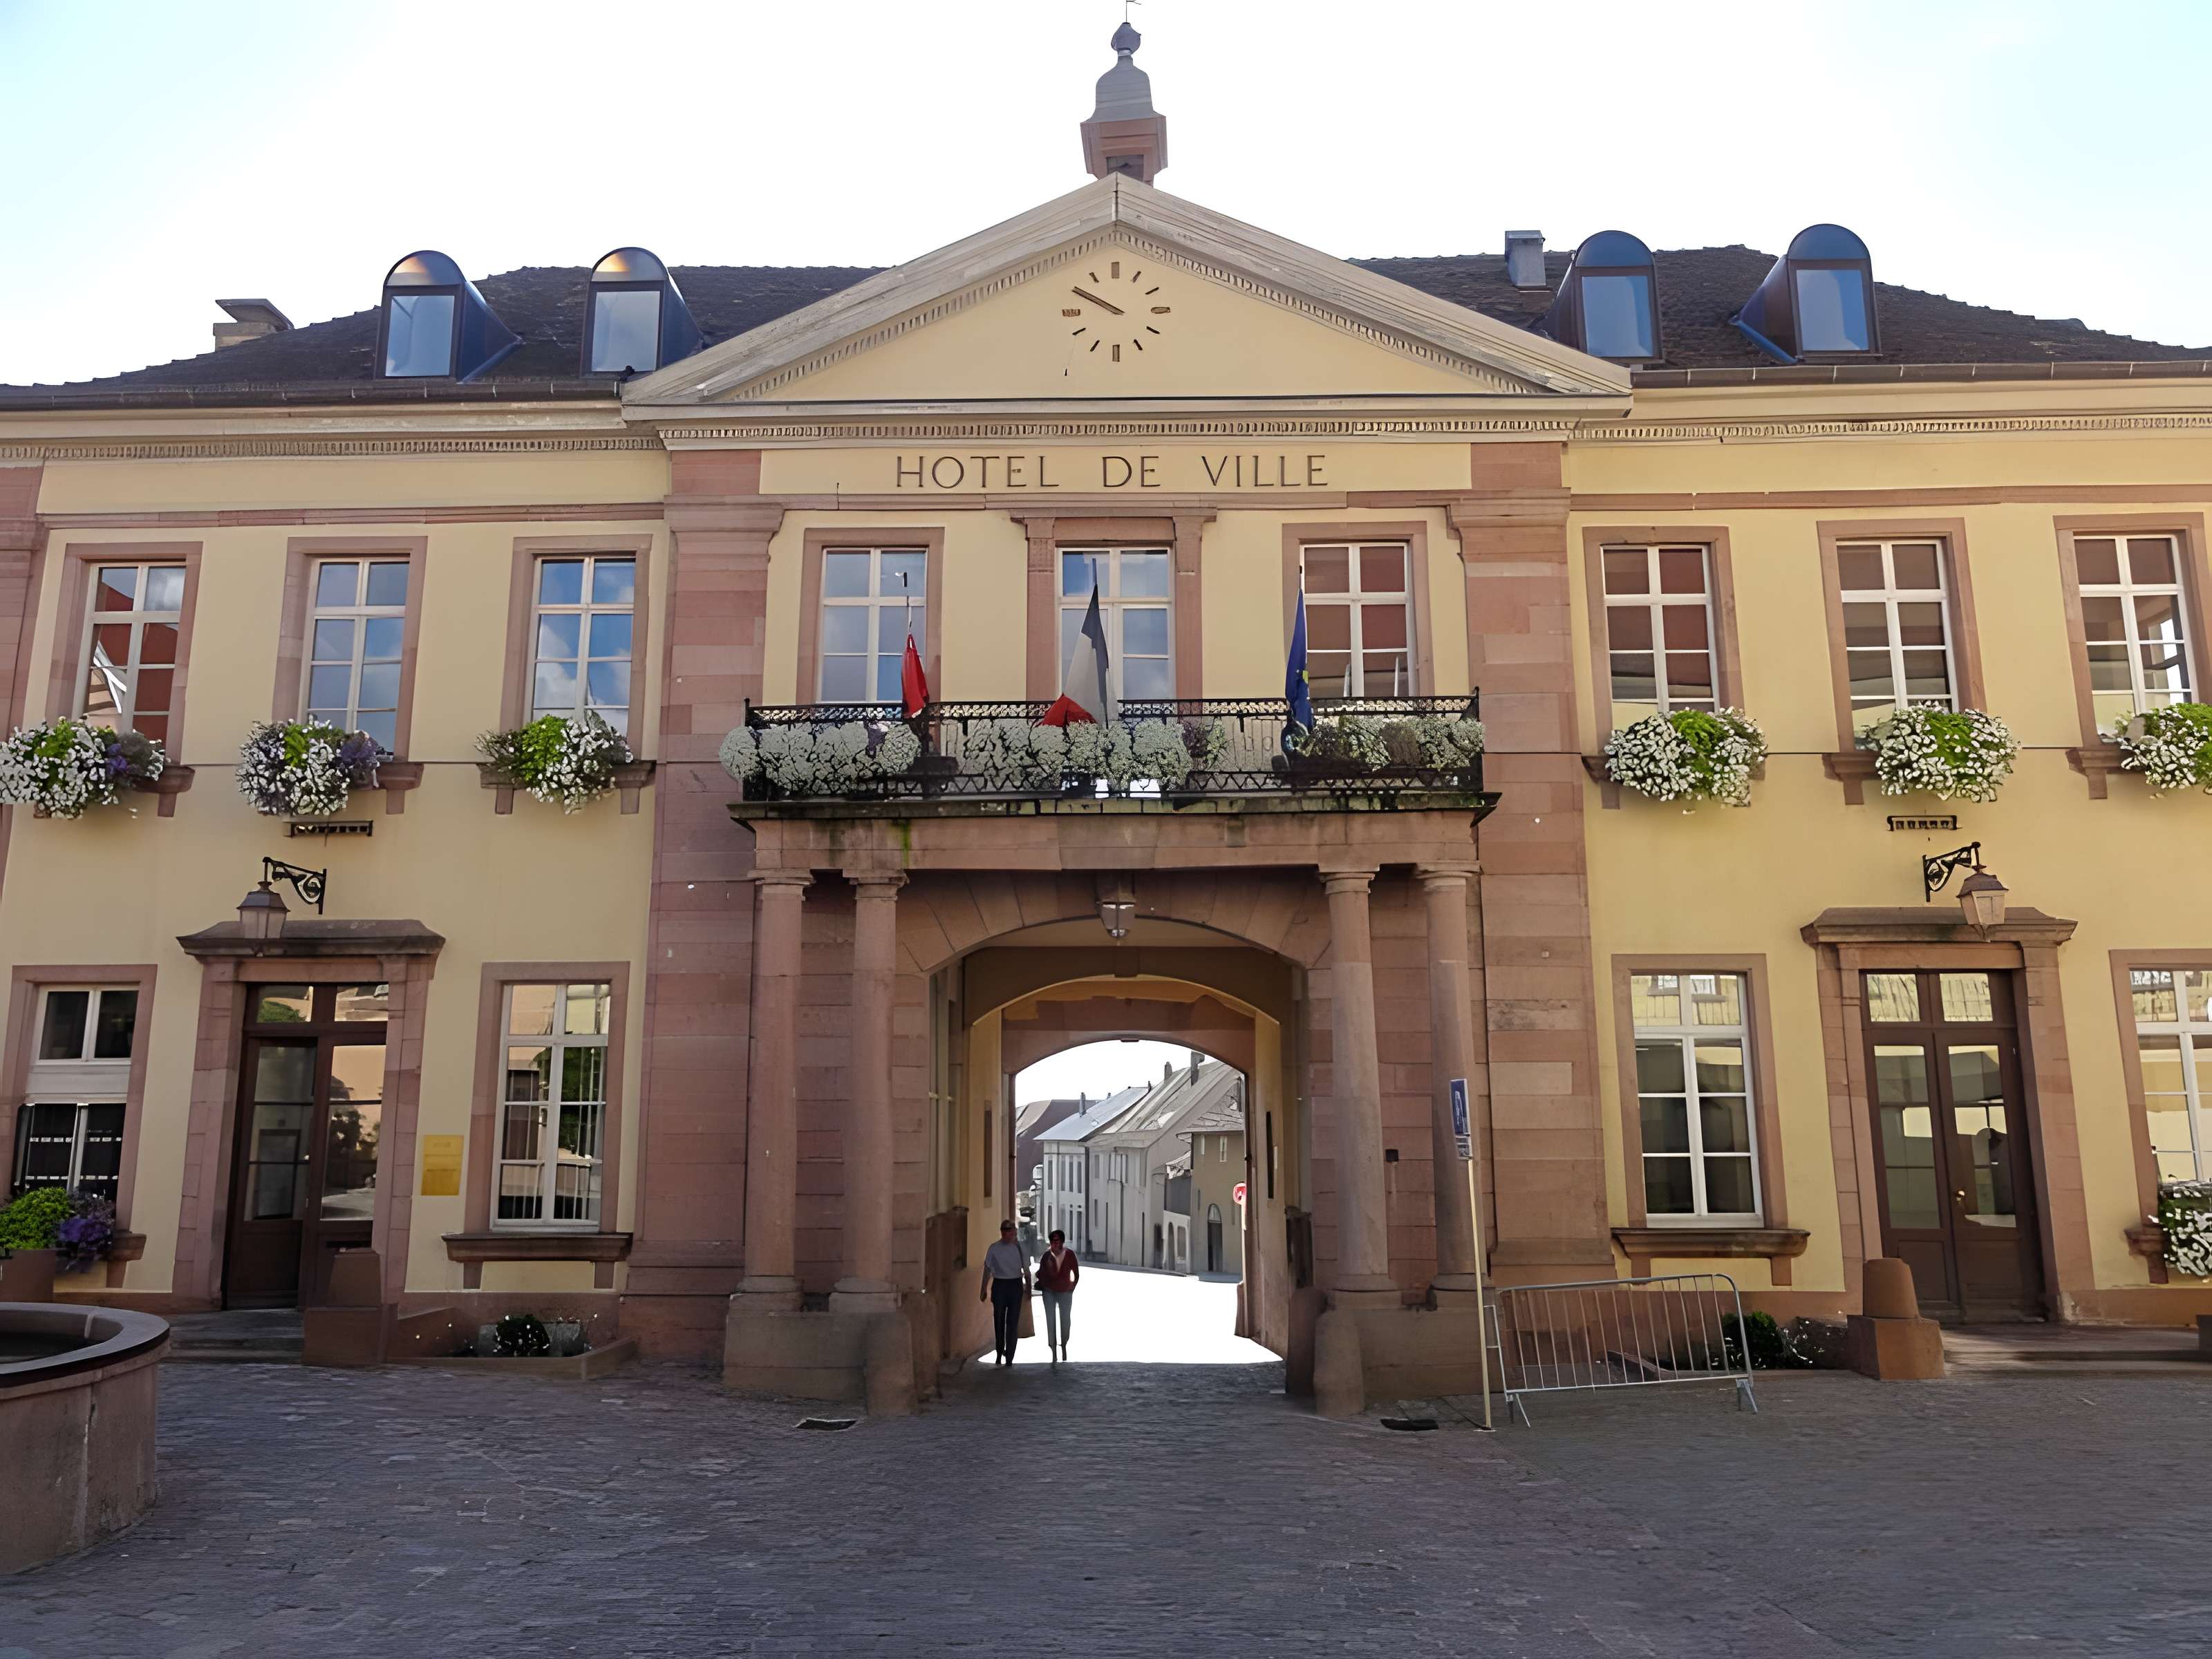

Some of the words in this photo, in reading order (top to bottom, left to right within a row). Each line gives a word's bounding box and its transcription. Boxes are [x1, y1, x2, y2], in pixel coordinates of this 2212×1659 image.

[897, 456, 1060, 489] HOTEL
[1102, 456, 1161, 487] DE
[1201, 455, 1328, 487] VILLE
